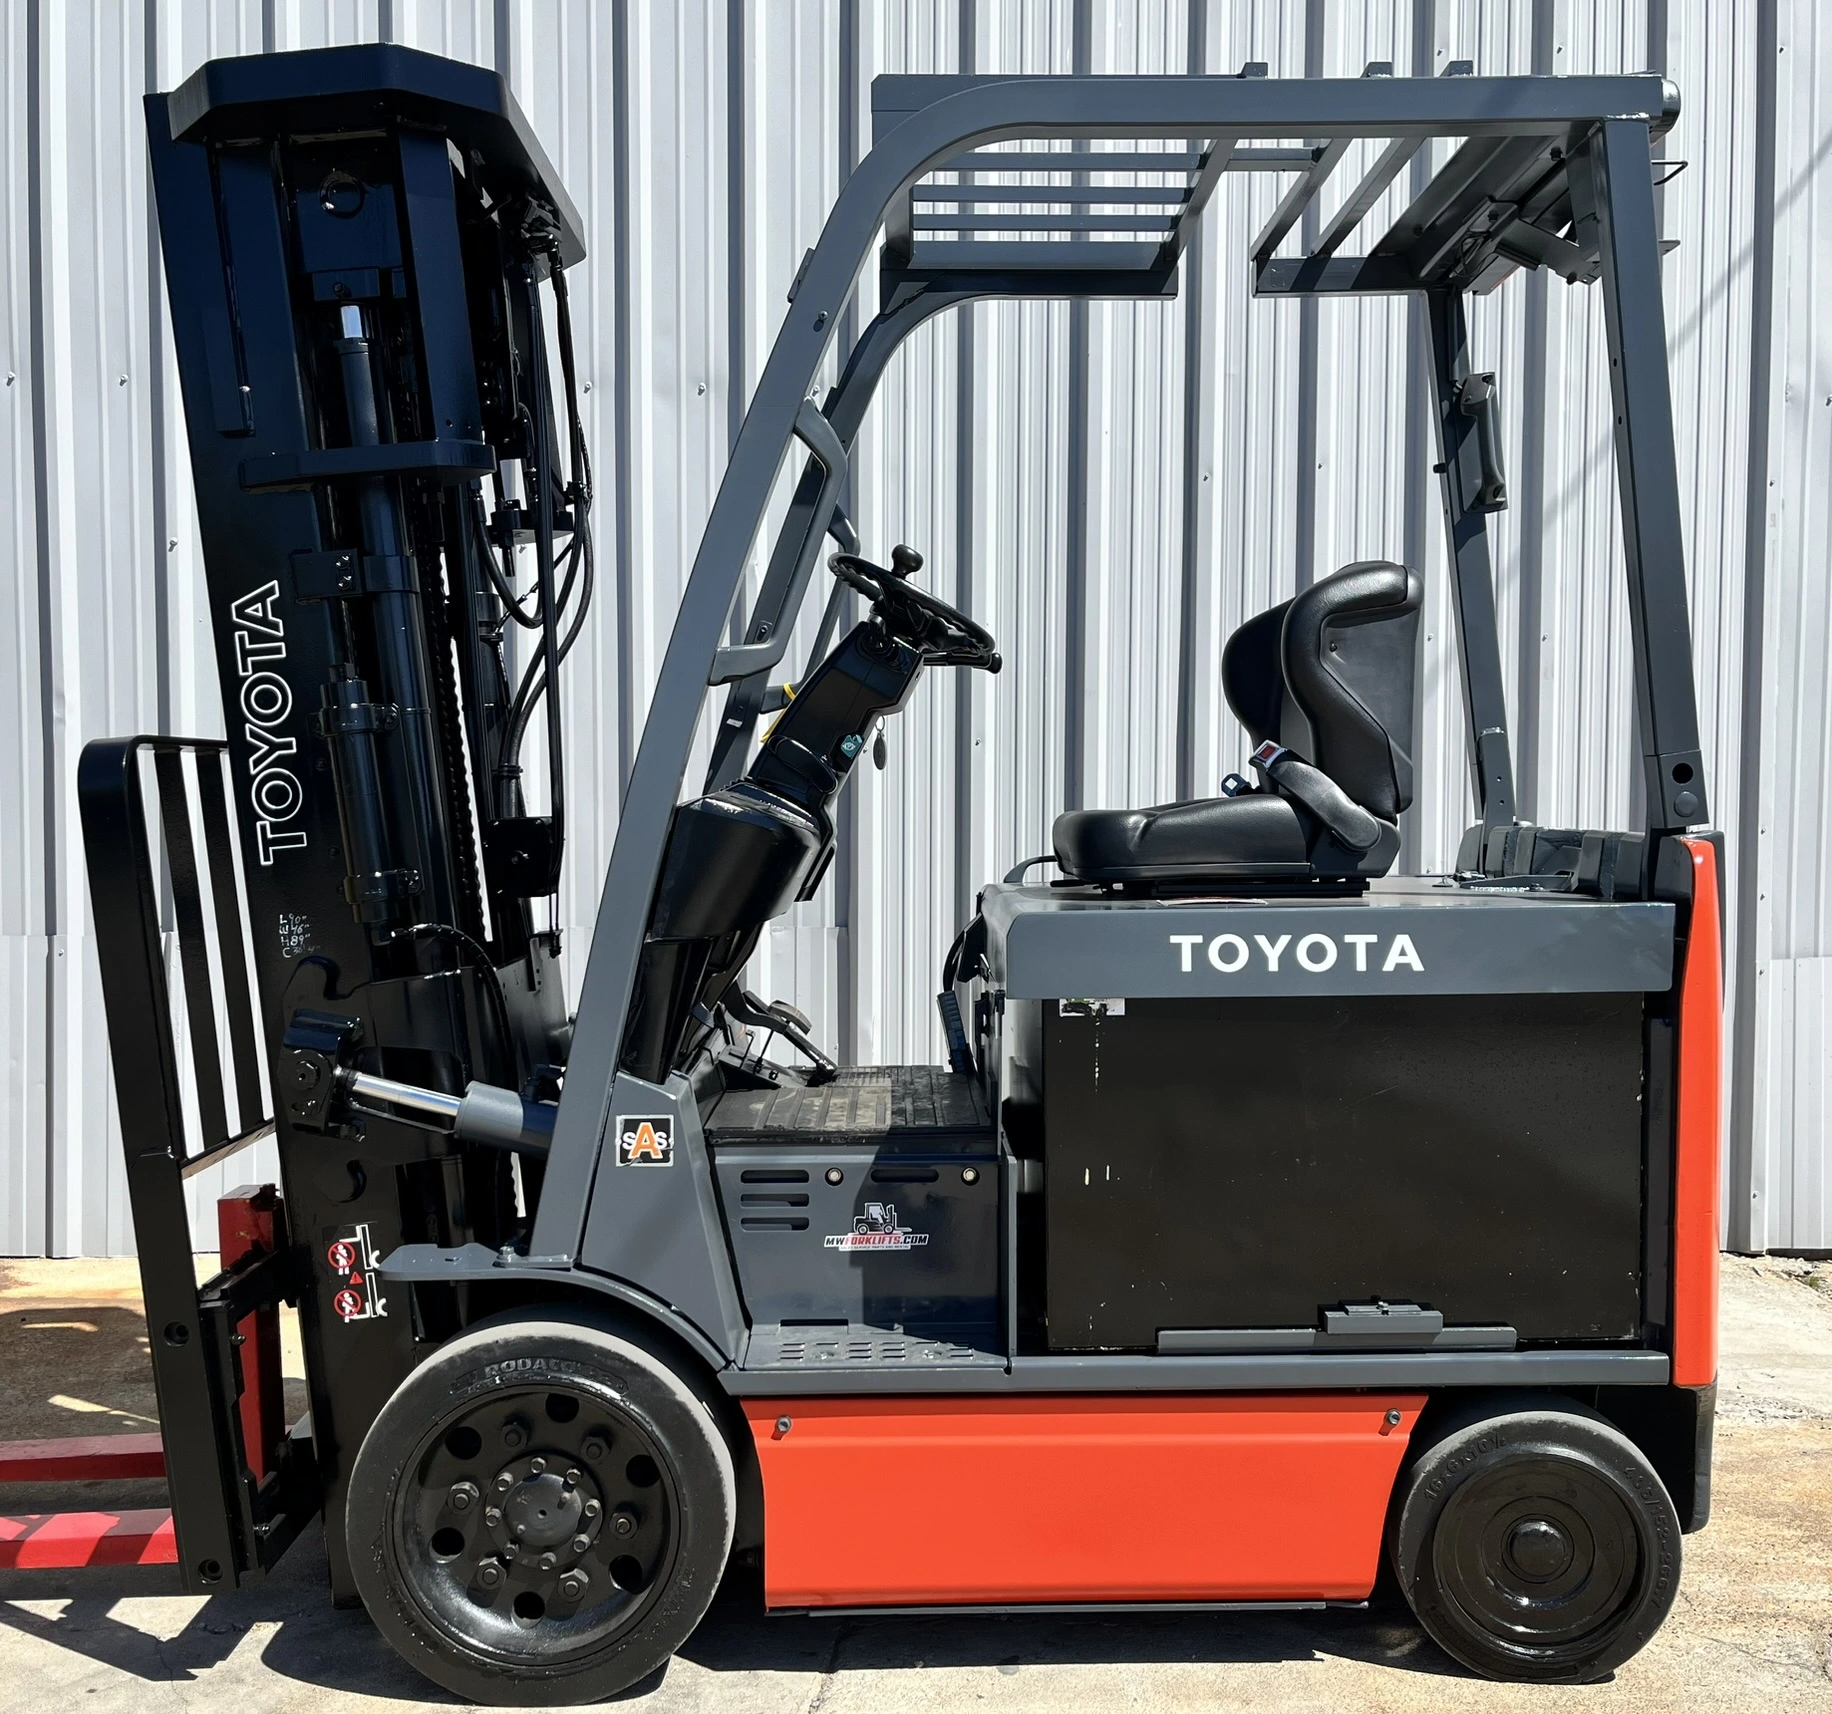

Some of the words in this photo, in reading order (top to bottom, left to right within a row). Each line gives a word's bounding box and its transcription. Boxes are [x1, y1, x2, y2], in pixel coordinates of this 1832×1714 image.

[231, 579, 307, 866] TOYOTA
[1169, 933, 1425, 973] TOYOTA
[825, 1235, 929, 1246] MWFORKLIFTS.COM
